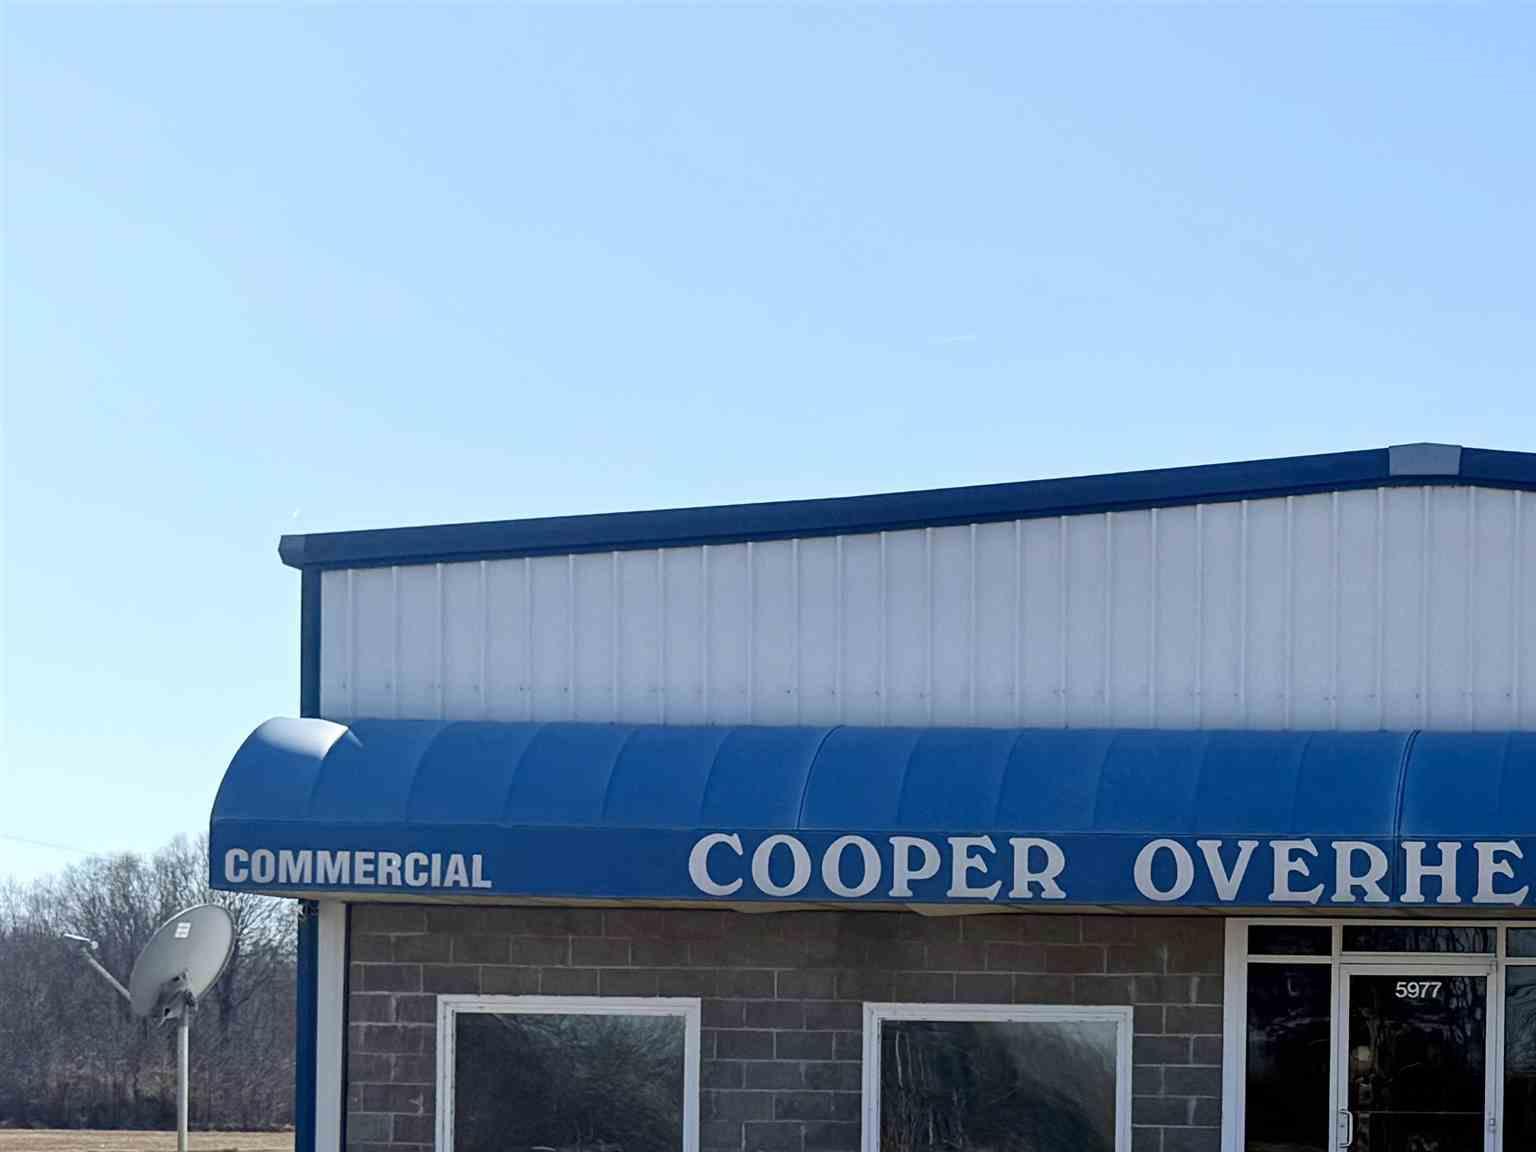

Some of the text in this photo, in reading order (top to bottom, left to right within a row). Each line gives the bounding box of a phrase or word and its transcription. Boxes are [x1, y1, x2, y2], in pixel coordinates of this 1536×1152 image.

[224, 847, 492, 889] COMMERCIAL
[687, 832, 1067, 901] COOPER
[1395, 981, 1443, 999] 5977
